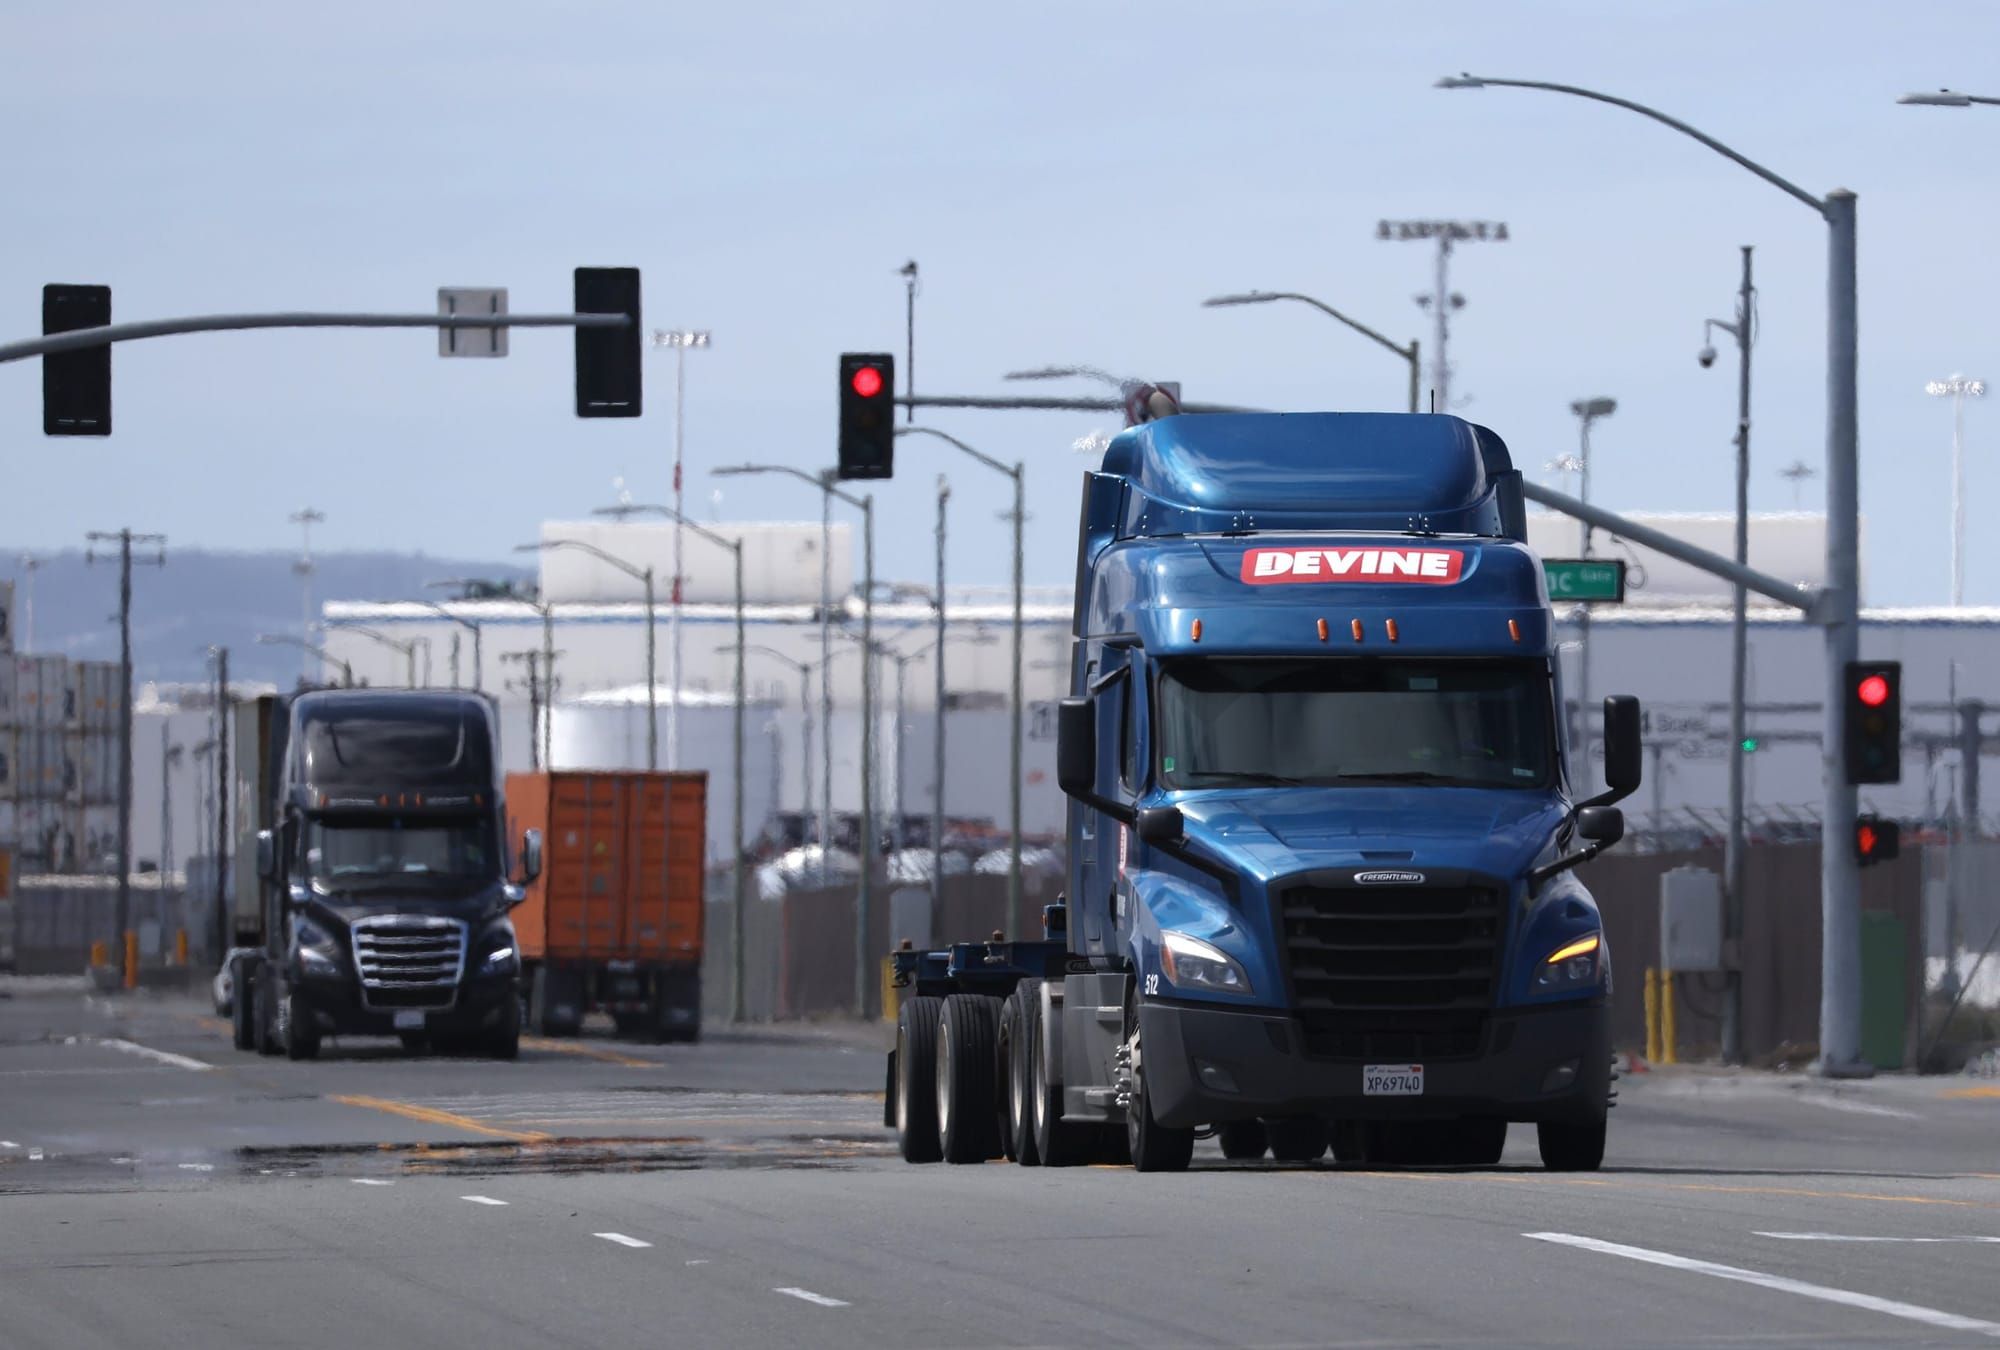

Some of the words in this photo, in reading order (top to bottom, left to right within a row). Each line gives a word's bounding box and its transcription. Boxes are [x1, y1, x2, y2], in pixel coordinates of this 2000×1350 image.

[1254, 551, 1450, 577] DEVINE
[1362, 873, 1419, 881] FREIGHTLINER
[1145, 974, 1159, 995] 512
[1367, 1075, 1420, 1092] XP69740
